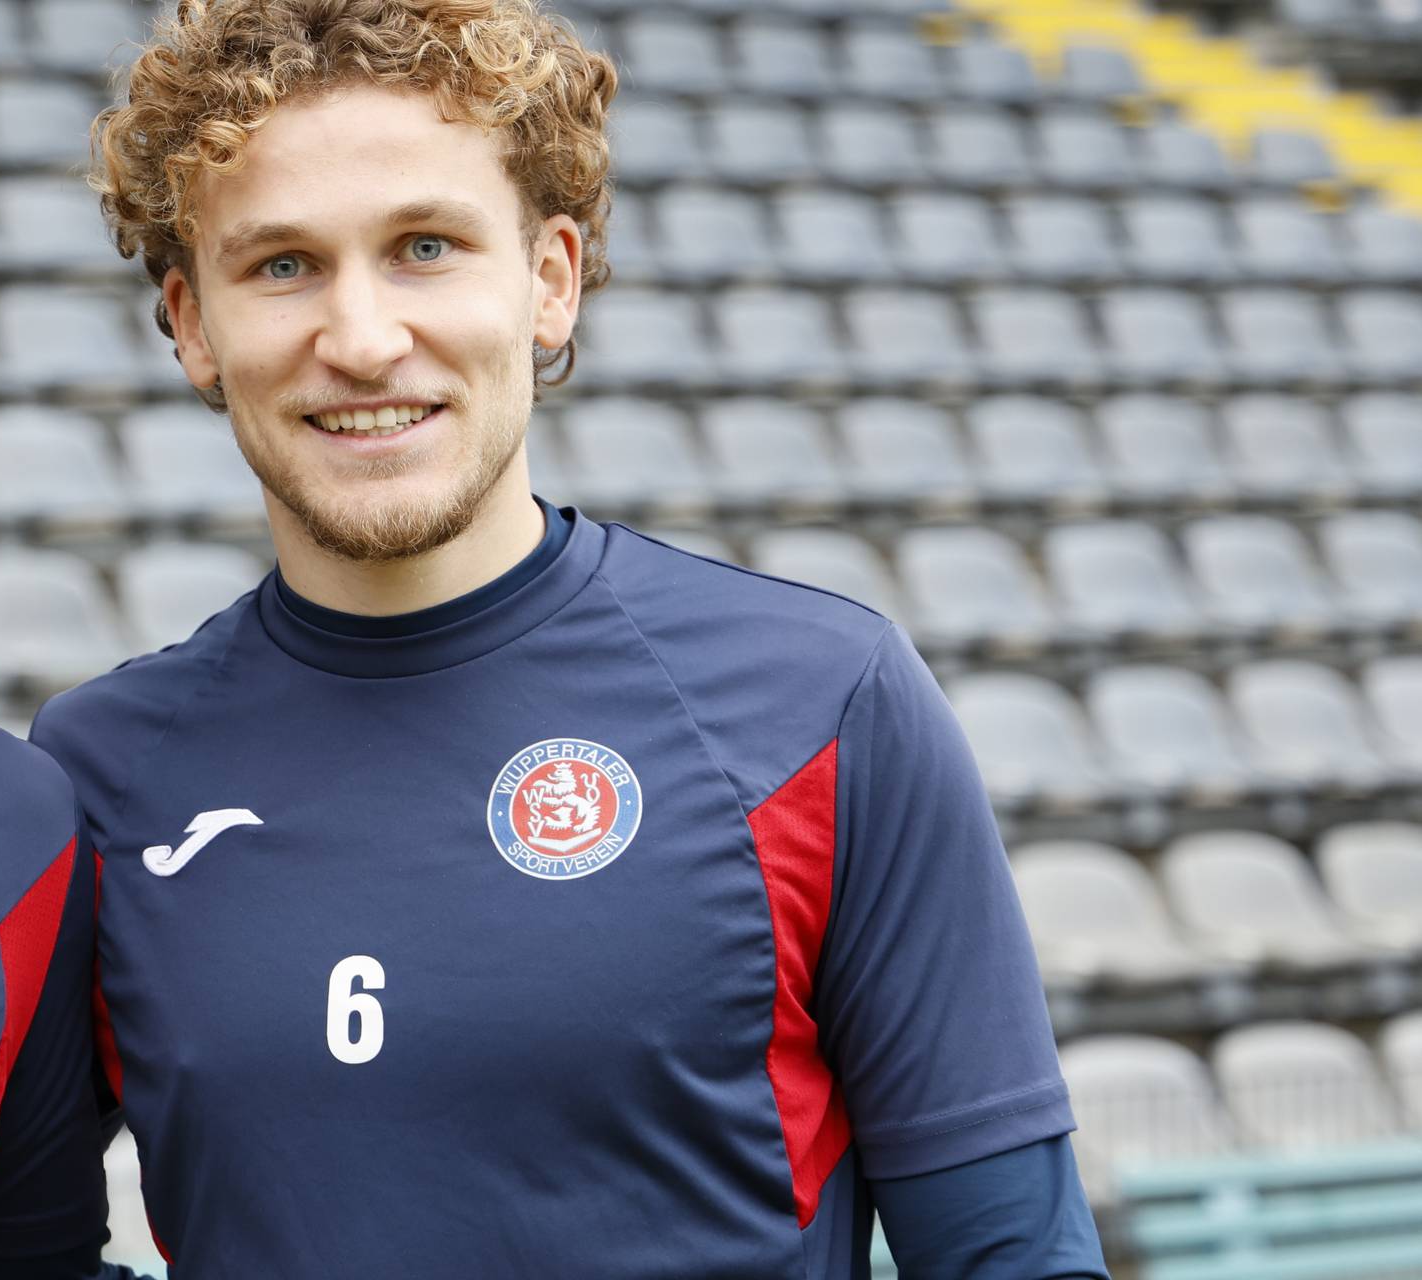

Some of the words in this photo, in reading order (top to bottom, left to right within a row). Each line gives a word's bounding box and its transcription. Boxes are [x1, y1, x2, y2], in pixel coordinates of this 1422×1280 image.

[497, 744, 629, 795] WUPPERTALER
[507, 832, 624, 874] SPORTVEREIN
[326, 954, 386, 1065] 6
